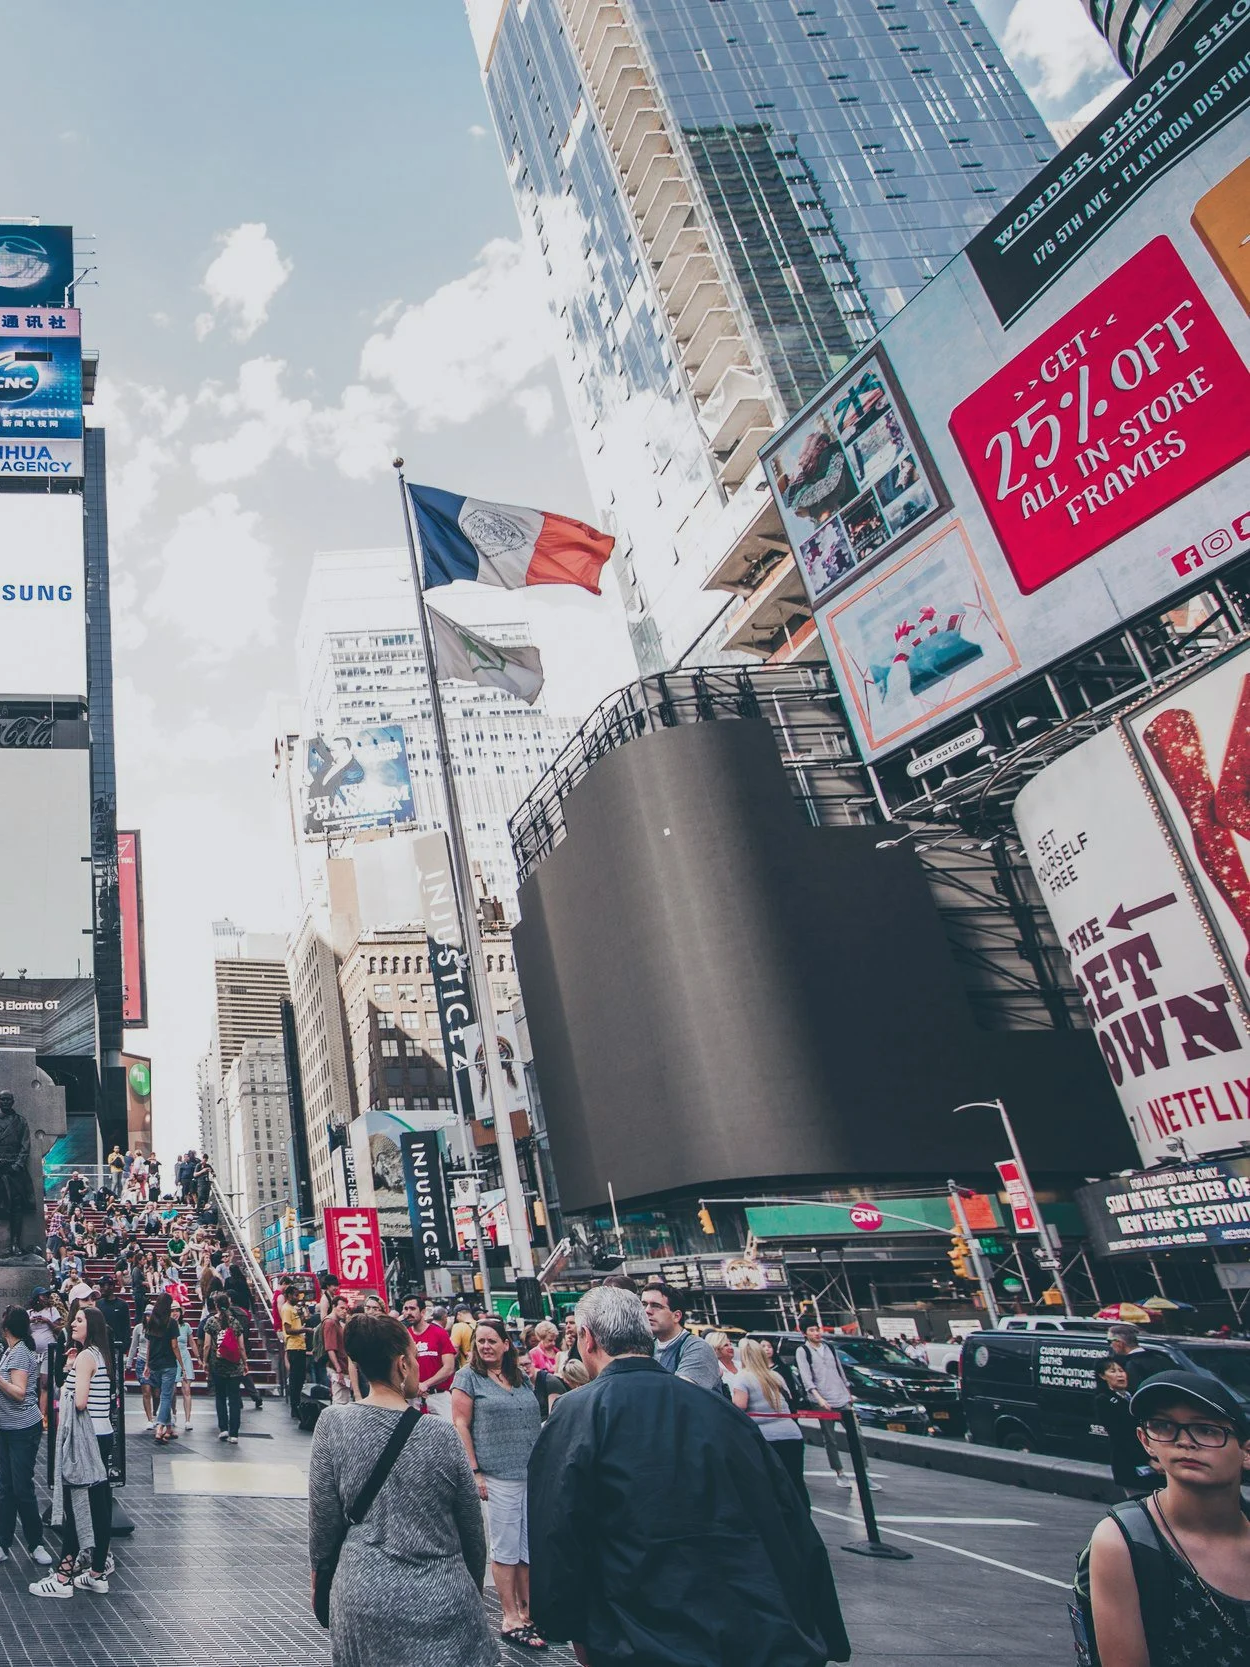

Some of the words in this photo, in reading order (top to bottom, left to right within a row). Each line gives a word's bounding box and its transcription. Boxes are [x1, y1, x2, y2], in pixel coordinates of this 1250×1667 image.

[993, 151, 1096, 249] WONDER
[1099, 59, 1187, 147] PHOTO
[1099, 110, 1163, 175] FUJIFILM
[1032, 237, 1058, 266] 176
[1056, 213, 1086, 246] 5TH
[1084, 185, 1113, 224] AVE
[1120, 111, 1196, 187] FLATIRON
[1040, 330, 1088, 383] GET
[985, 364, 1108, 502] 25%
[1110, 299, 1195, 390] OFF
[1020, 472, 1069, 520] ALL
[1074, 366, 1214, 479] IN-STORE
[1, 461, 72, 473] AGENCY
[1065, 430, 1187, 526] FRAMES
[914, 757, 934, 771] city
[936, 734, 976, 759] outdoor
[1037, 829, 1057, 857] SET
[1049, 864, 1079, 898] FREE
[1067, 917, 1105, 957] THE
[5, 1001, 43, 1011] Elantra
[45, 1000, 60, 1010] GT
[1175, 1170, 1197, 1183] TIME
[1105, 1193, 1130, 1214] STAY
[1127, 1191, 1145, 1211] IN
[1142, 1187, 1170, 1209] THE
[1167, 1180, 1230, 1205] CENTER
[1117, 1214, 1144, 1235] NEW
[1141, 1208, 1190, 1232] YEAR'S
[338, 1213, 373, 1281] tkts
[1039, 1346, 1070, 1357] CUSTOM
[1039, 1356, 1063, 1366] BATHS
[1039, 1366, 1052, 1375] AIR
[1039, 1375, 1064, 1386] MAJOR
